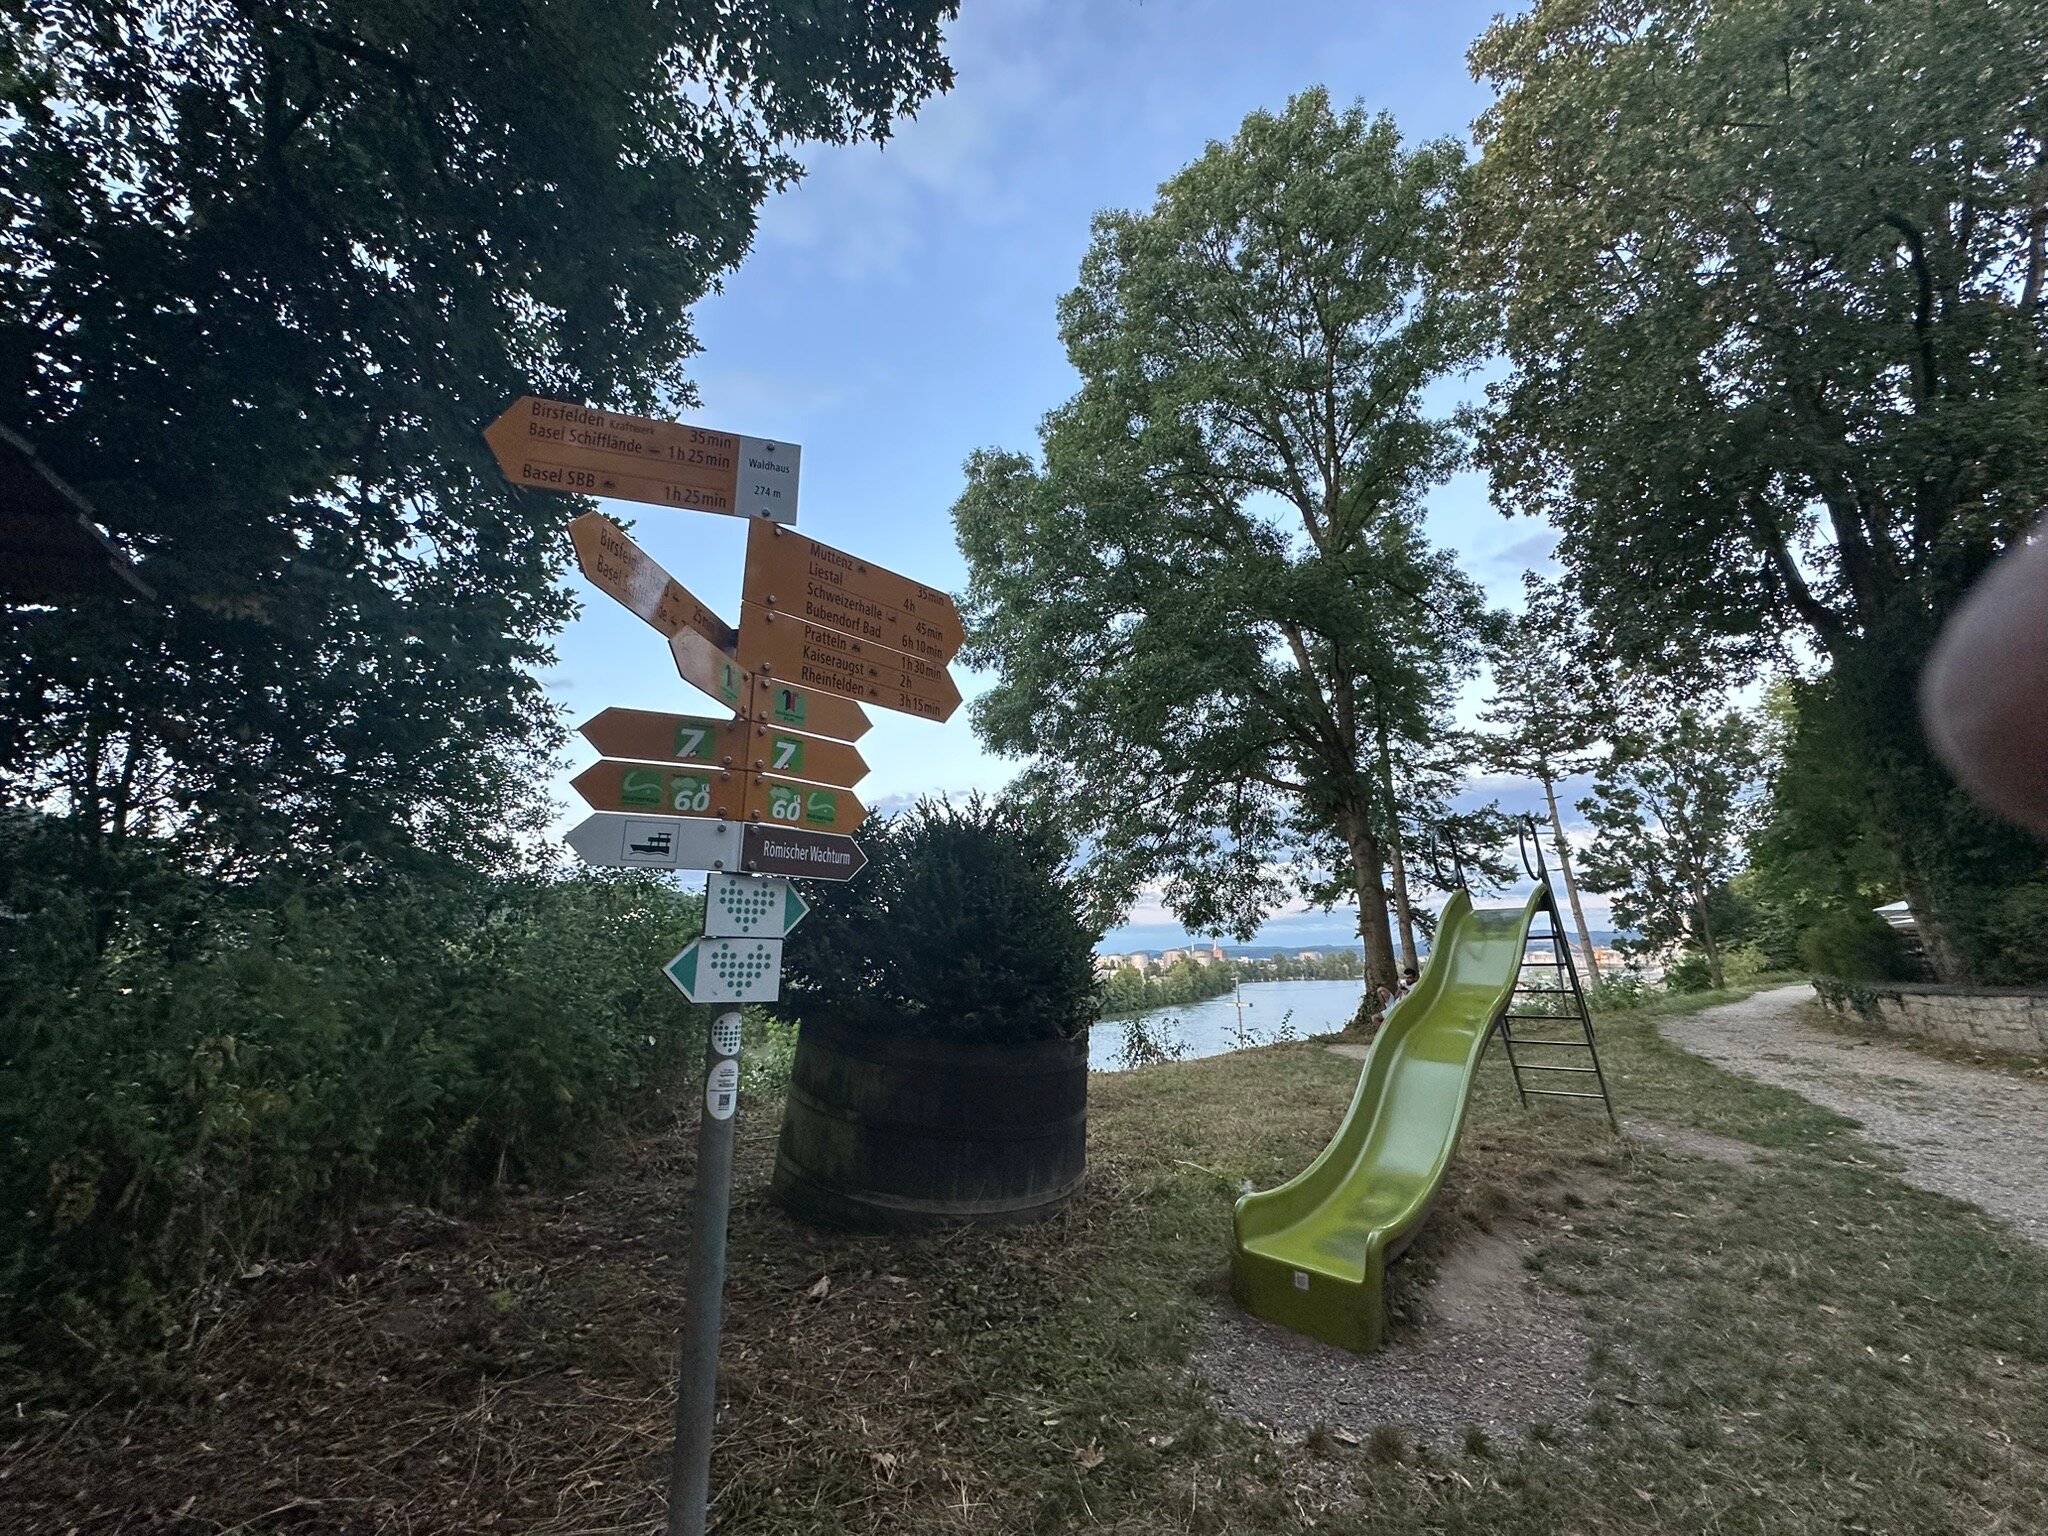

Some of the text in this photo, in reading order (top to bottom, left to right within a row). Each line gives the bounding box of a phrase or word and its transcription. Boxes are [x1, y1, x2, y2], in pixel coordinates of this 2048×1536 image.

[532, 402, 605, 427] Birsfelden
[609, 421, 655, 434] Kraftwerk
[529, 423, 564, 439] Basel
[569, 429, 642, 453] Schifflände
[523, 464, 563, 483] Basel
[567, 471, 595, 487] SBB
[749, 458, 790, 474] Waldhaus
[754, 485, 781, 498] 274 m
[597, 554, 622, 588] Basel
[810, 543, 854, 571] Muttenz
[809, 562, 843, 586] Liestal
[807, 583, 882, 620] Schweizerhalle
[806, 602, 861, 631] Bubendorf
[862, 622, 881, 638] Bad
[804, 625, 847, 651] Pratteln
[802, 646, 864, 676] Kaiseraugst
[801, 667, 864, 695] Rheinfelden
[676, 728, 706, 757] 7
[772, 741, 796, 769] 7
[674, 789, 710, 812] 60
[772, 799, 801, 821] 60
[763, 840, 851, 865] Römischer Wachturm
